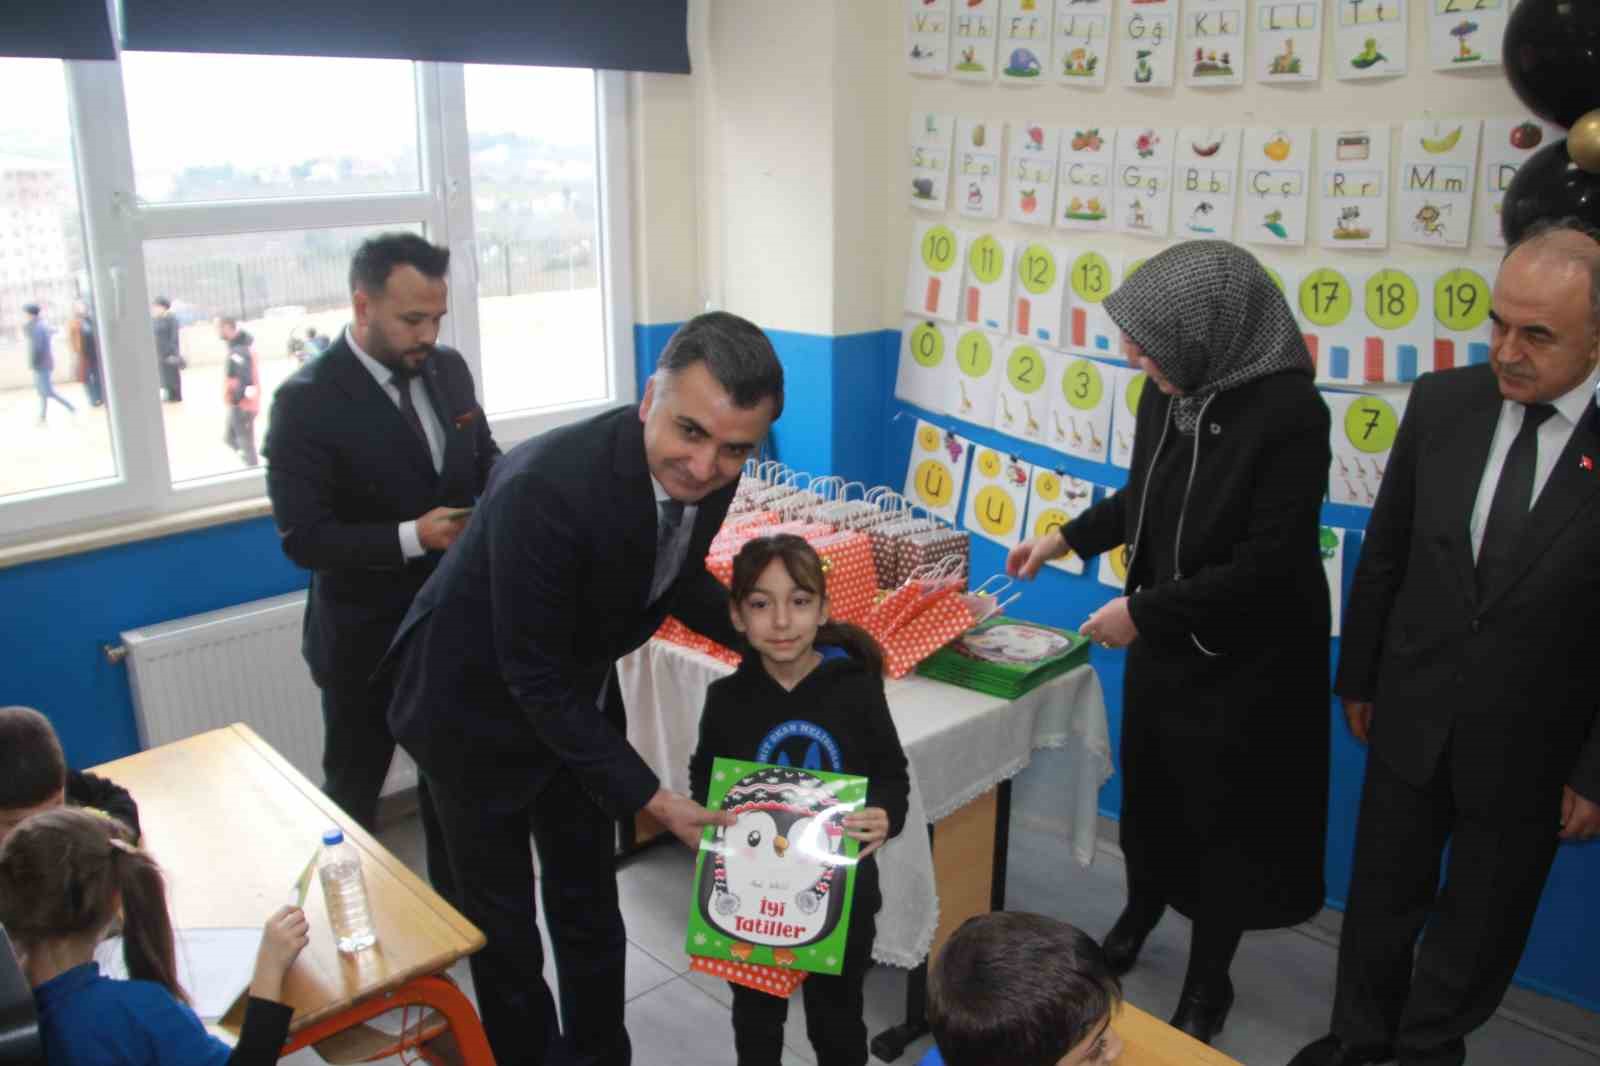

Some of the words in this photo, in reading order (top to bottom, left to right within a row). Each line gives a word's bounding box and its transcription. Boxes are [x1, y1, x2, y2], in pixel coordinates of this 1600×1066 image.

[929, 236, 950, 263] 10
[981, 247, 993, 274] 11
[1027, 256, 1048, 284] 12
[1081, 263, 1103, 292] 13
[1311, 282, 1339, 313] 17
[1375, 283, 1405, 316] 18
[1445, 283, 1477, 318] 19
[1018, 356, 1034, 383] 2
[1074, 372, 1090, 399] 3
[1361, 408, 1380, 440] 7
[735, 915, 806, 939] Tatiller
